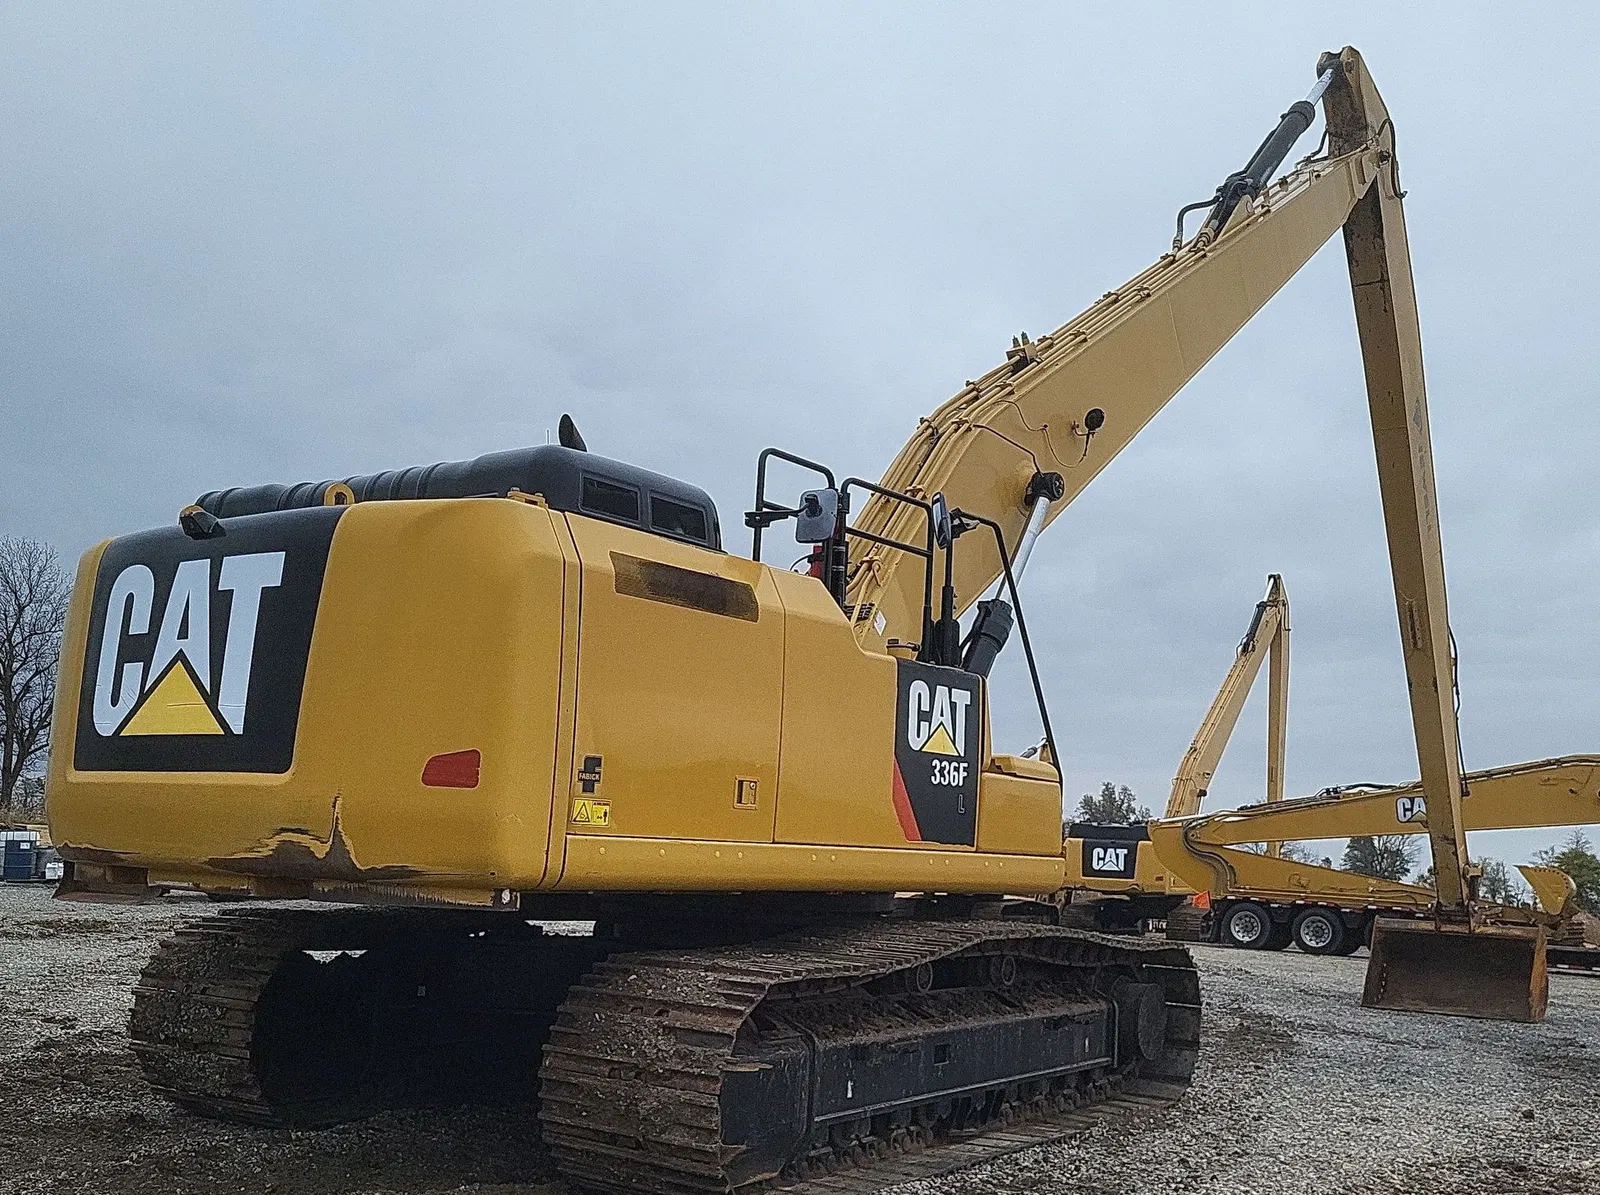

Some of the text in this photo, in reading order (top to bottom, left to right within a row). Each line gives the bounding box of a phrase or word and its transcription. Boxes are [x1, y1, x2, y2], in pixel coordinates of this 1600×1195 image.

[93, 551, 286, 736] CAT
[908, 680, 971, 757] CAT
[579, 772, 600, 780] FABICK
[931, 759, 968, 787] 336F
[1397, 797, 1427, 822] CA
[1092, 847, 1128, 871] CAT
